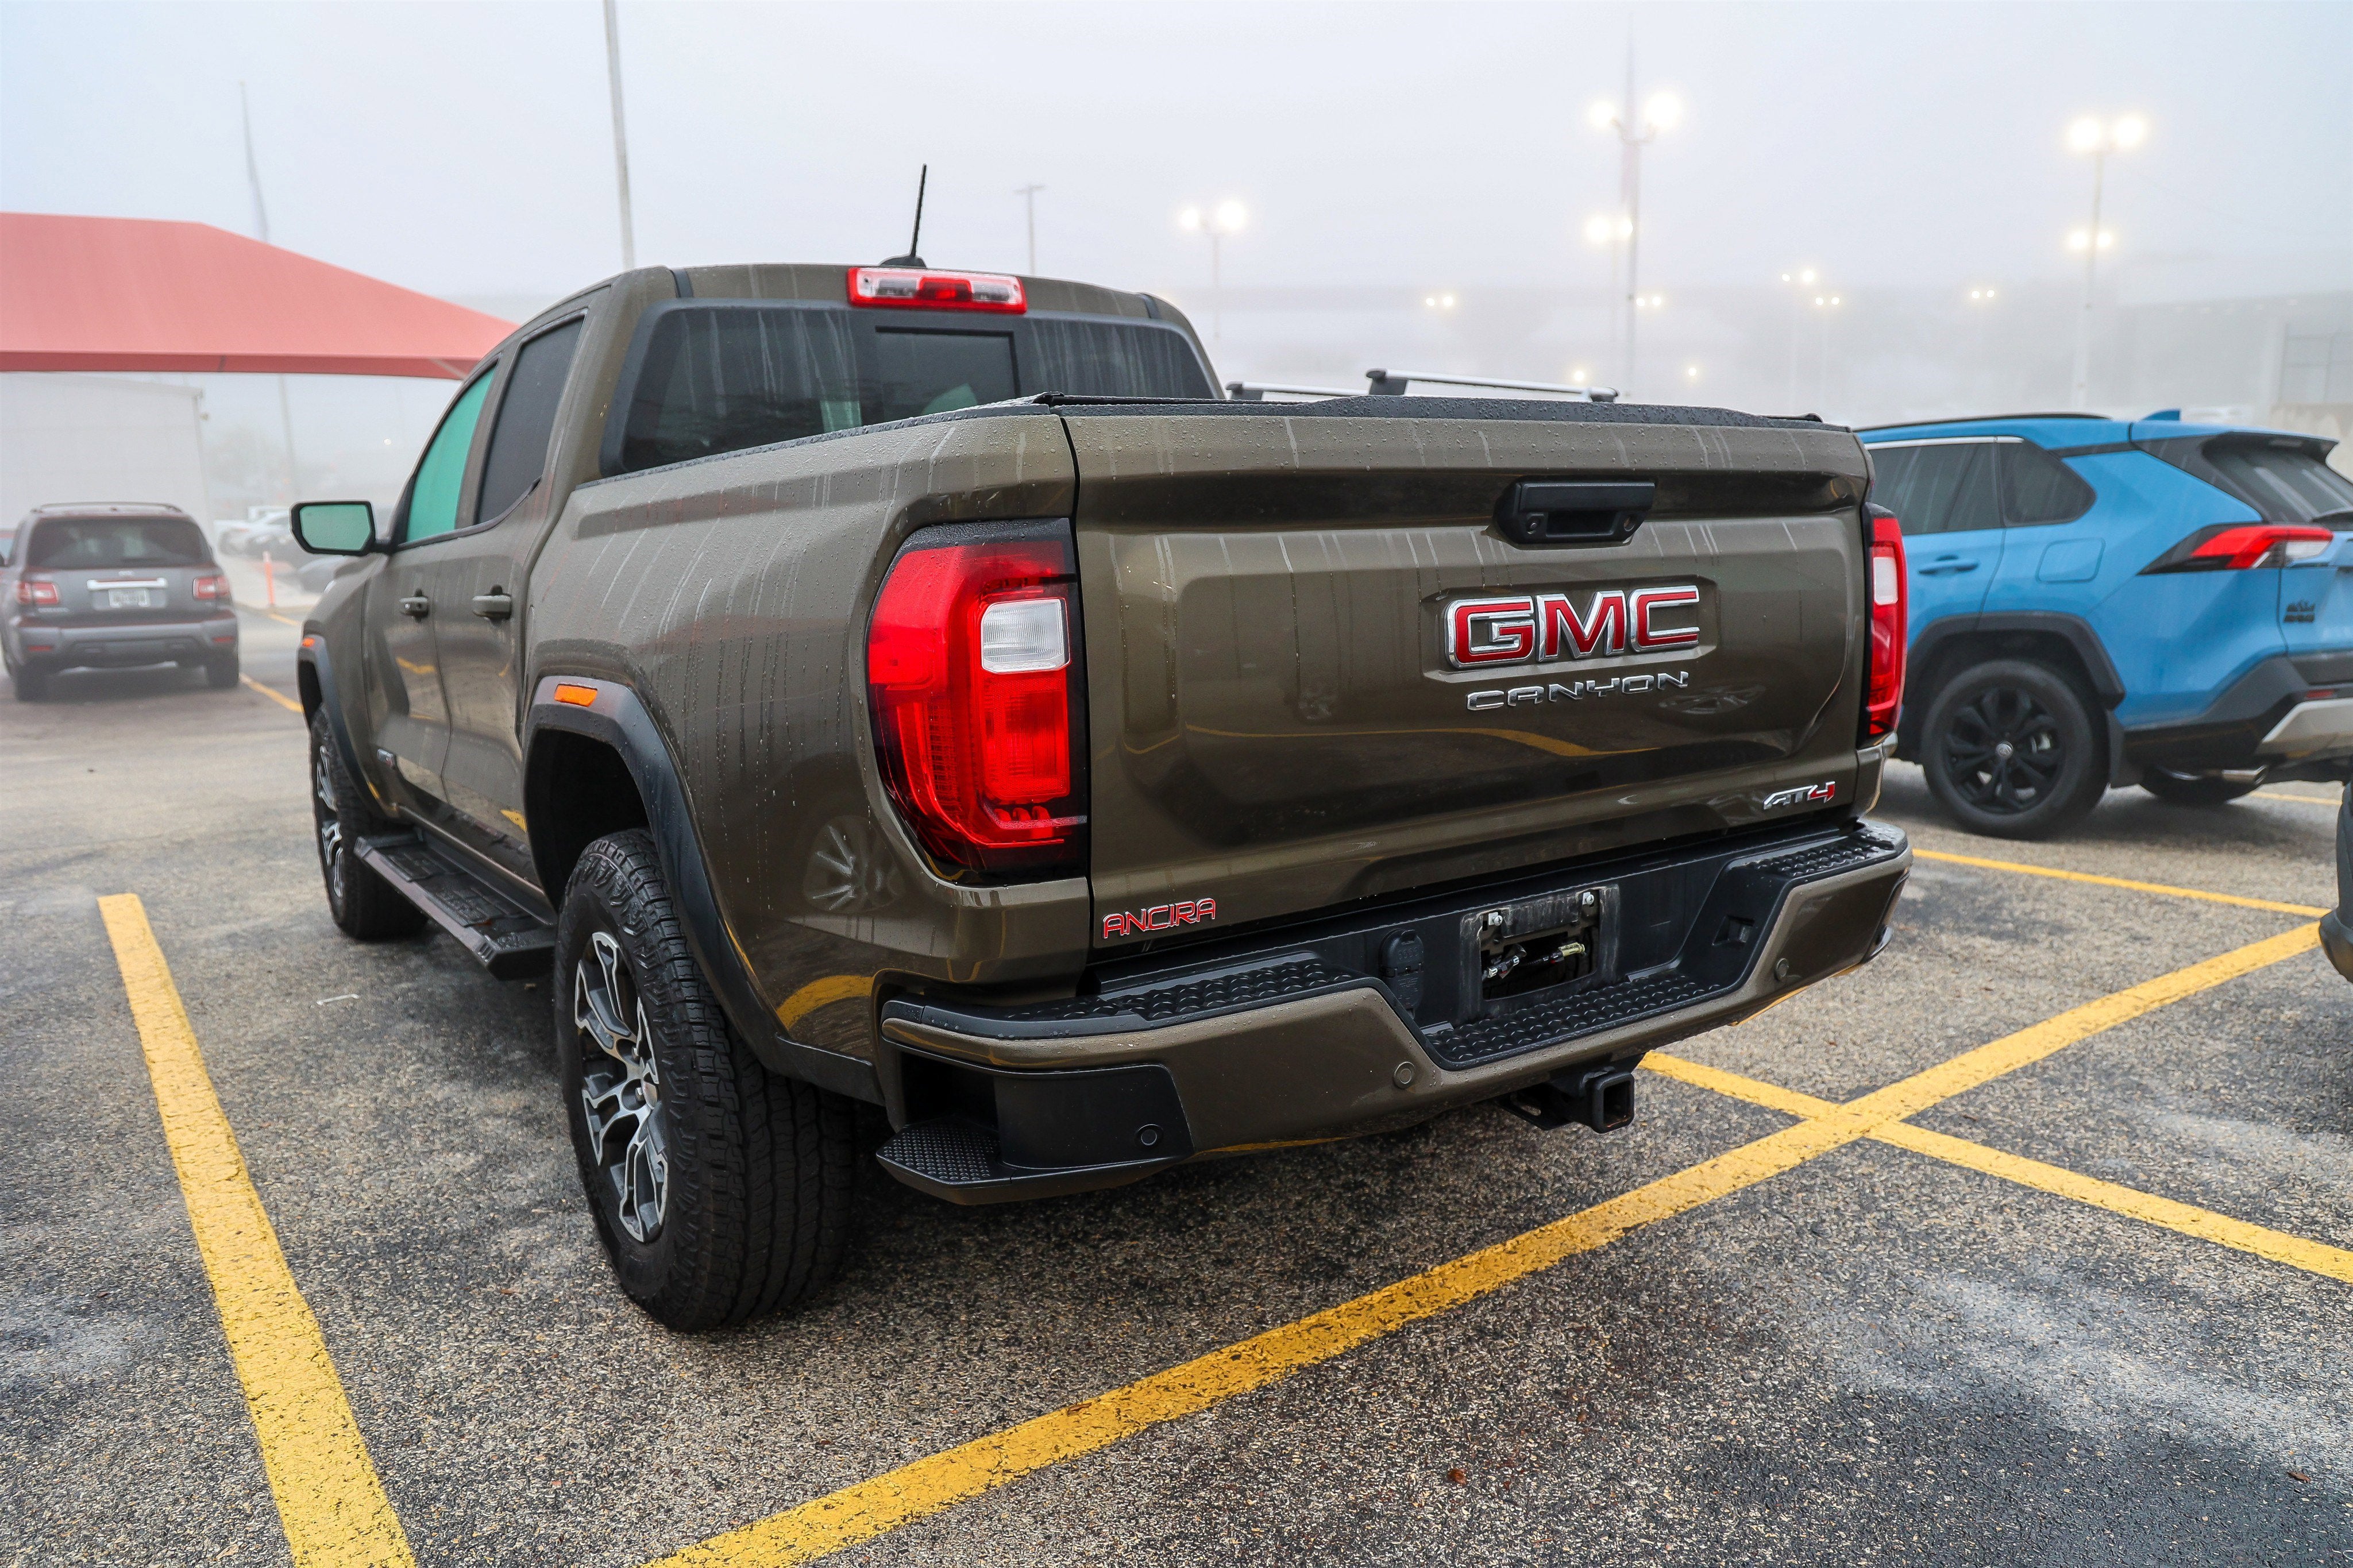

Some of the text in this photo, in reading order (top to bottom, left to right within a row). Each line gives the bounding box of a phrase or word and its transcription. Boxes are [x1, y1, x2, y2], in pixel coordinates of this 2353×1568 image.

[1445, 585, 1700, 669] GMC
[1466, 670, 1689, 711] CANYON
[1763, 781, 1835, 810] AT4
[1102, 897, 1216, 939] ANCIRA
